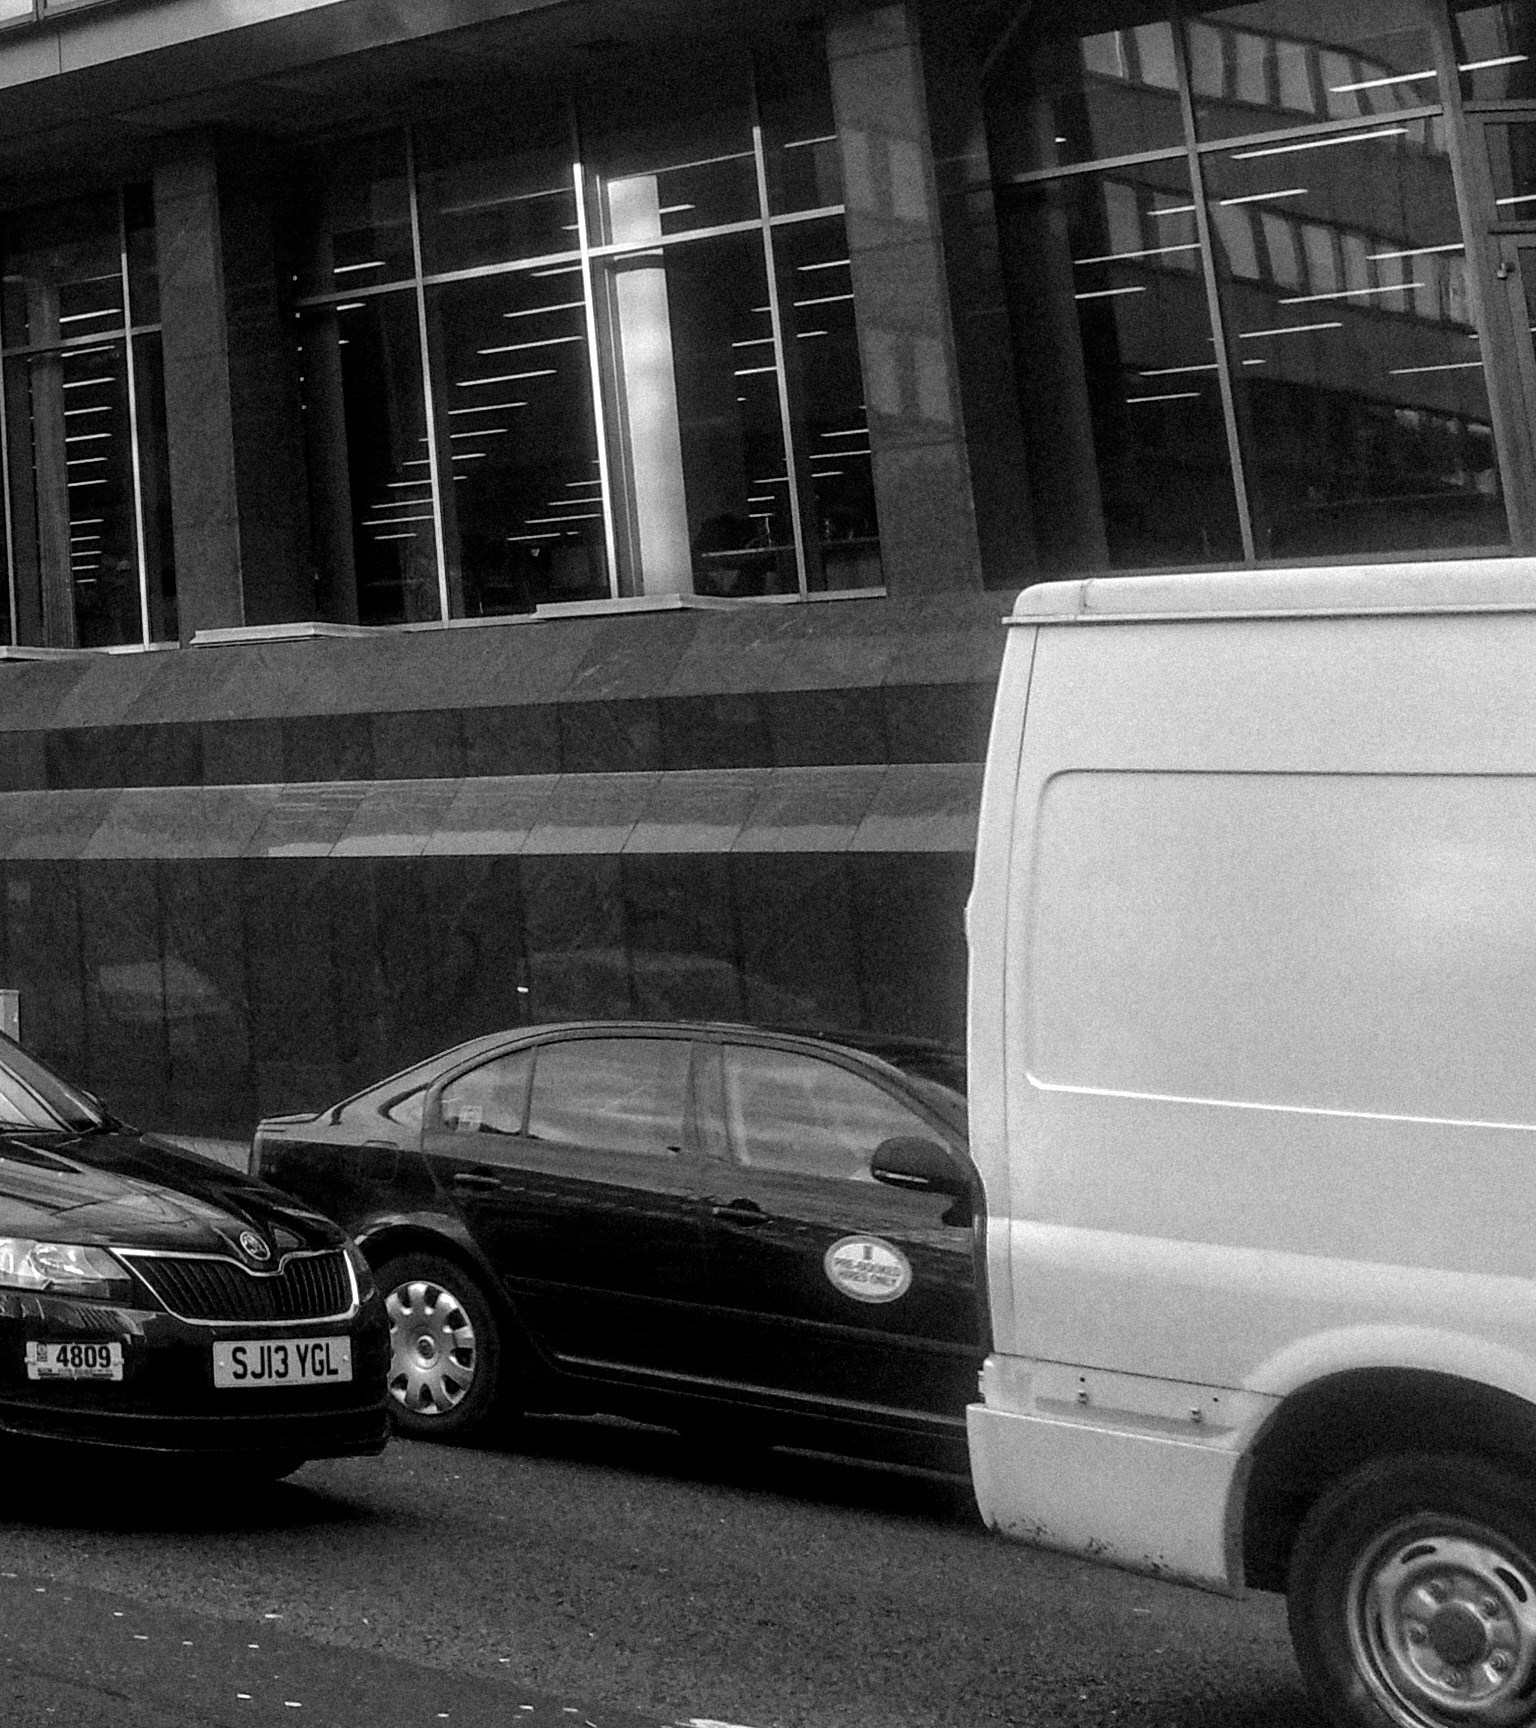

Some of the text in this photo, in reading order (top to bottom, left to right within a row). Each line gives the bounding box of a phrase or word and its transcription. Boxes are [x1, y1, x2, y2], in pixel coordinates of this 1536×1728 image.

[56, 1344, 111, 1368] 4809
[231, 1342, 339, 1380] SJ13 YGL
